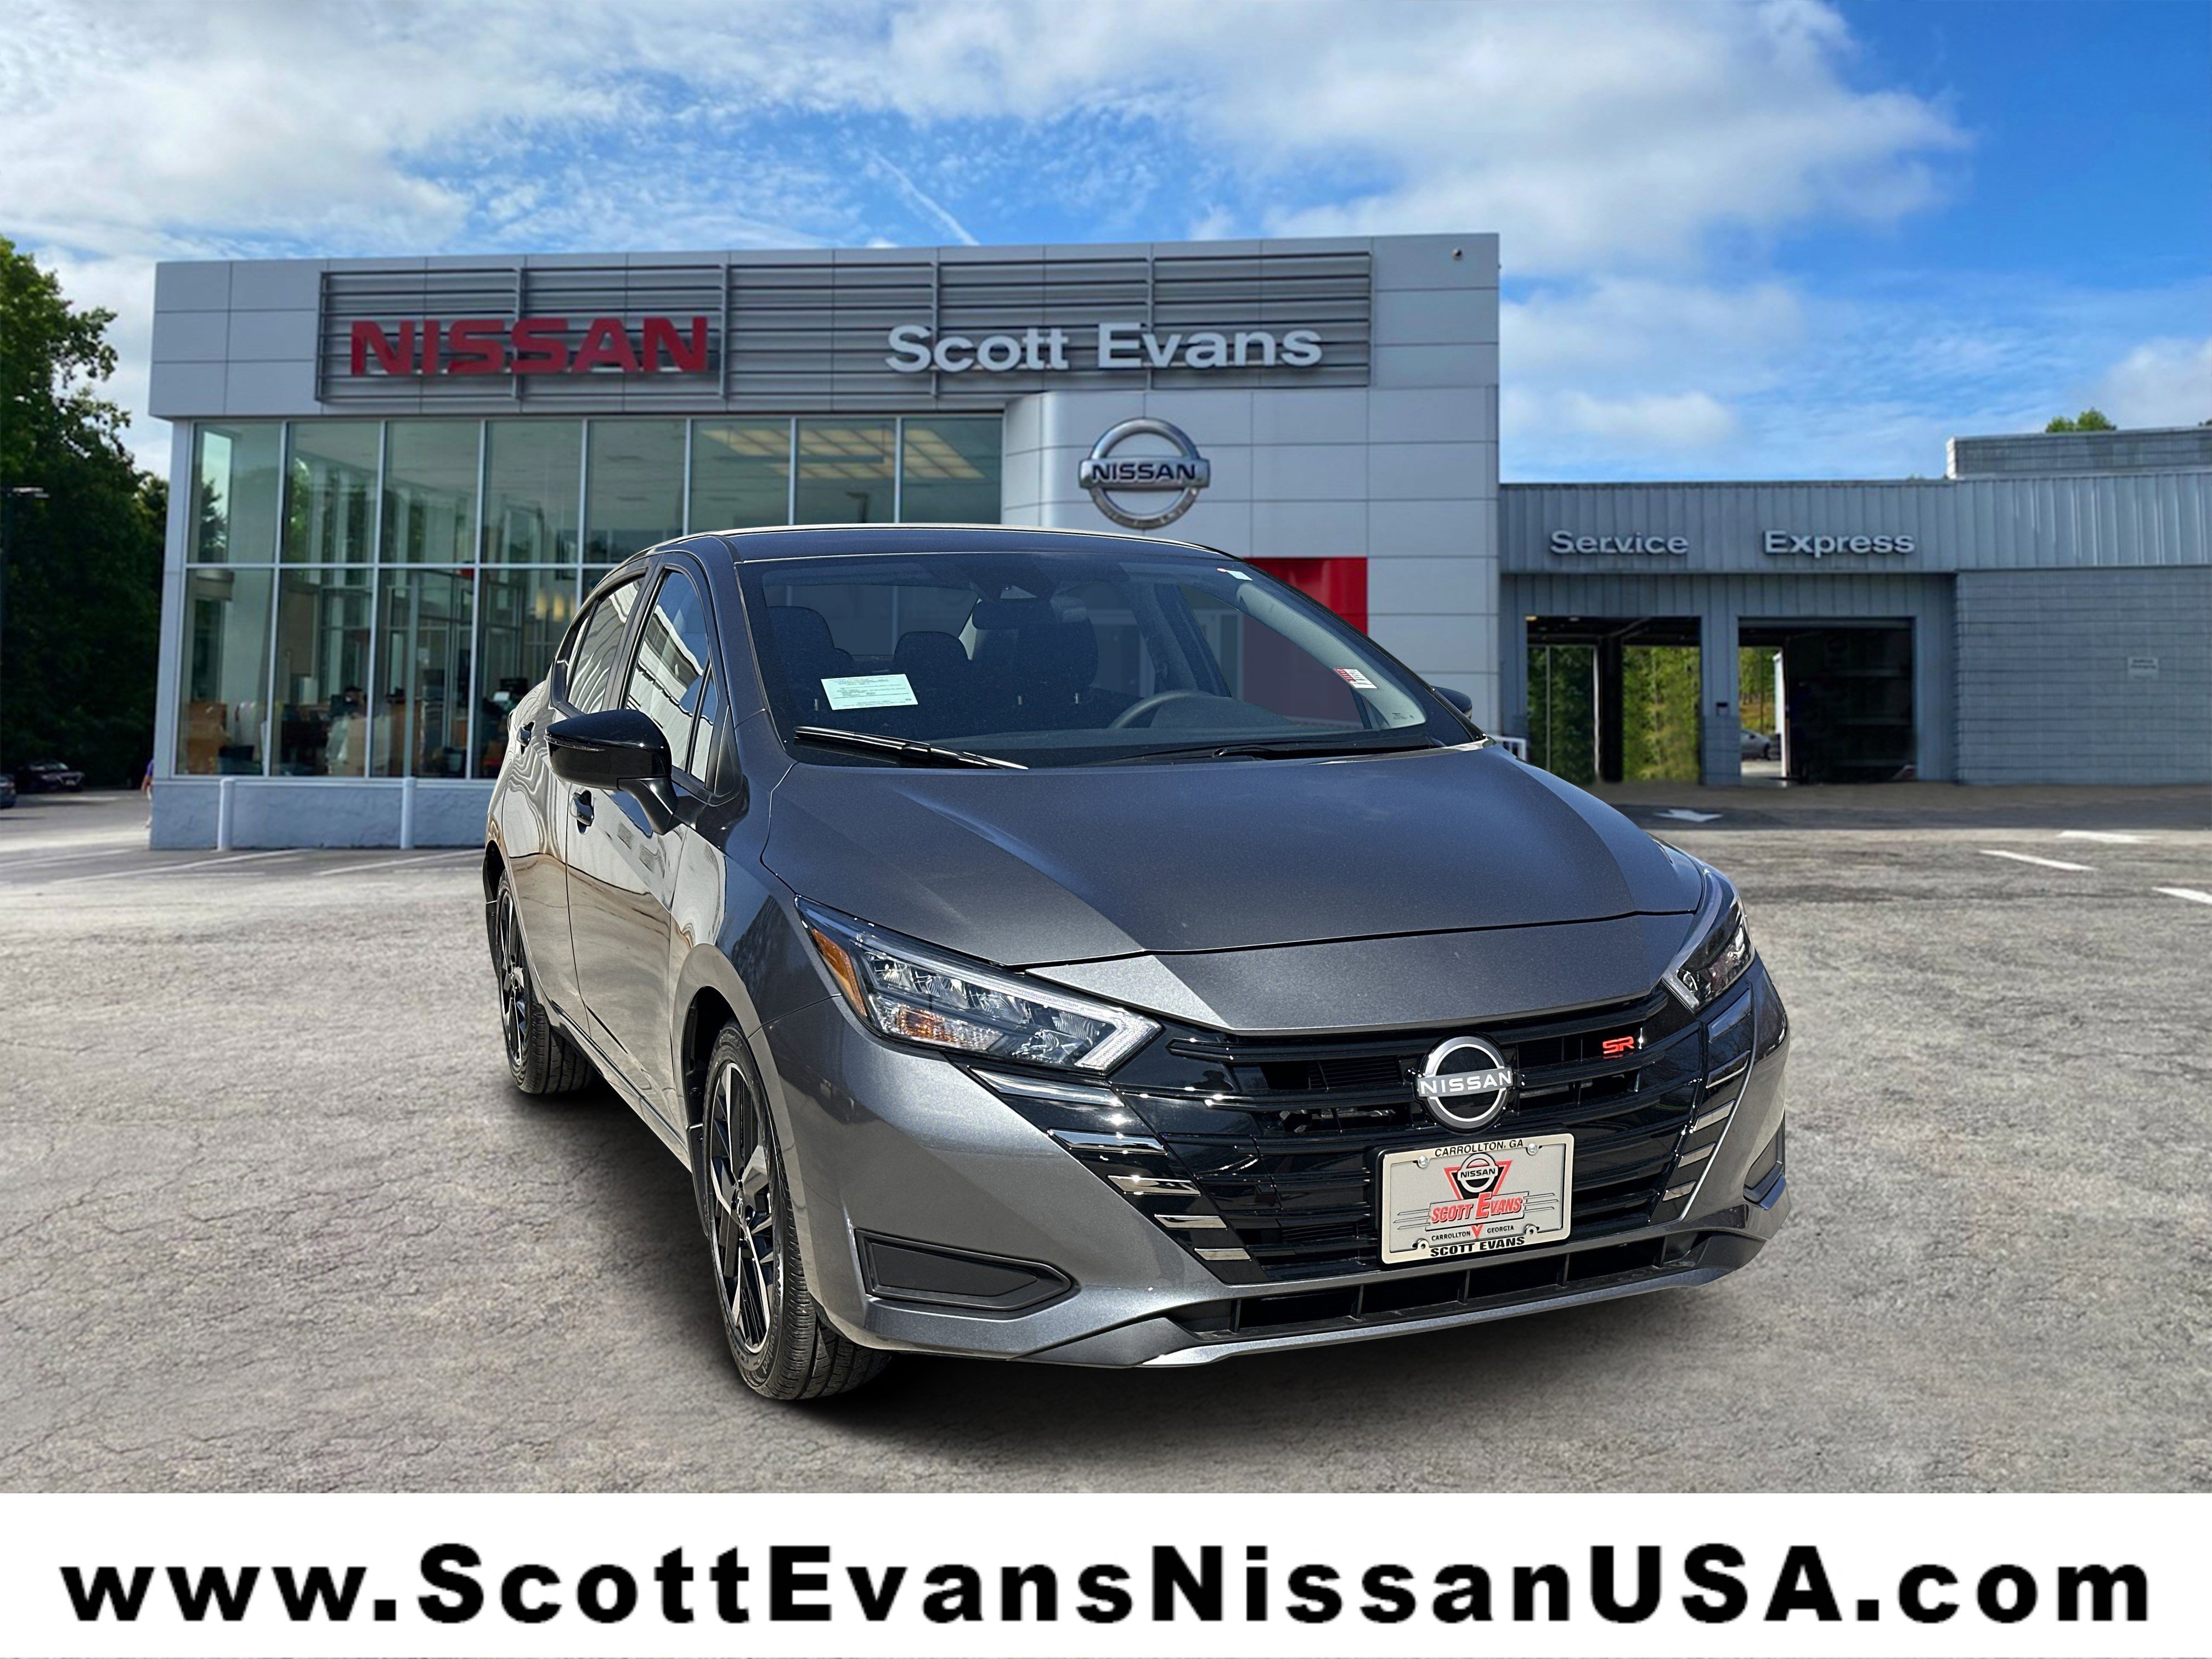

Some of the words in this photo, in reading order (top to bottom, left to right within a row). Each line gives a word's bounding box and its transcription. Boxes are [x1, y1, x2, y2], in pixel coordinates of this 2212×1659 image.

[352, 317, 708, 375] NISSAN
[885, 325, 1069, 372] Scott
[1098, 322, 1323, 369] Evans
[1092, 464, 1195, 481] NISSAN
[1550, 530, 1689, 555] Service
[1764, 530, 1915, 558] Express
[1602, 1036, 1634, 1054] SR
[1420, 1070, 1512, 1095] NISSAN
[1435, 1141, 1506, 1157] CARROLLTON,
[1509, 1139, 1523, 1148] GA
[1460, 1168, 1496, 1178] NISSAN
[1431, 1203, 1474, 1223] SCOTT
[1431, 1231, 1471, 1241] CARROLLTON
[1487, 1225, 1514, 1233] GEORGIA
[1430, 1243, 1475, 1257] SCOTT
[1480, 1236, 1525, 1251] EVANS
